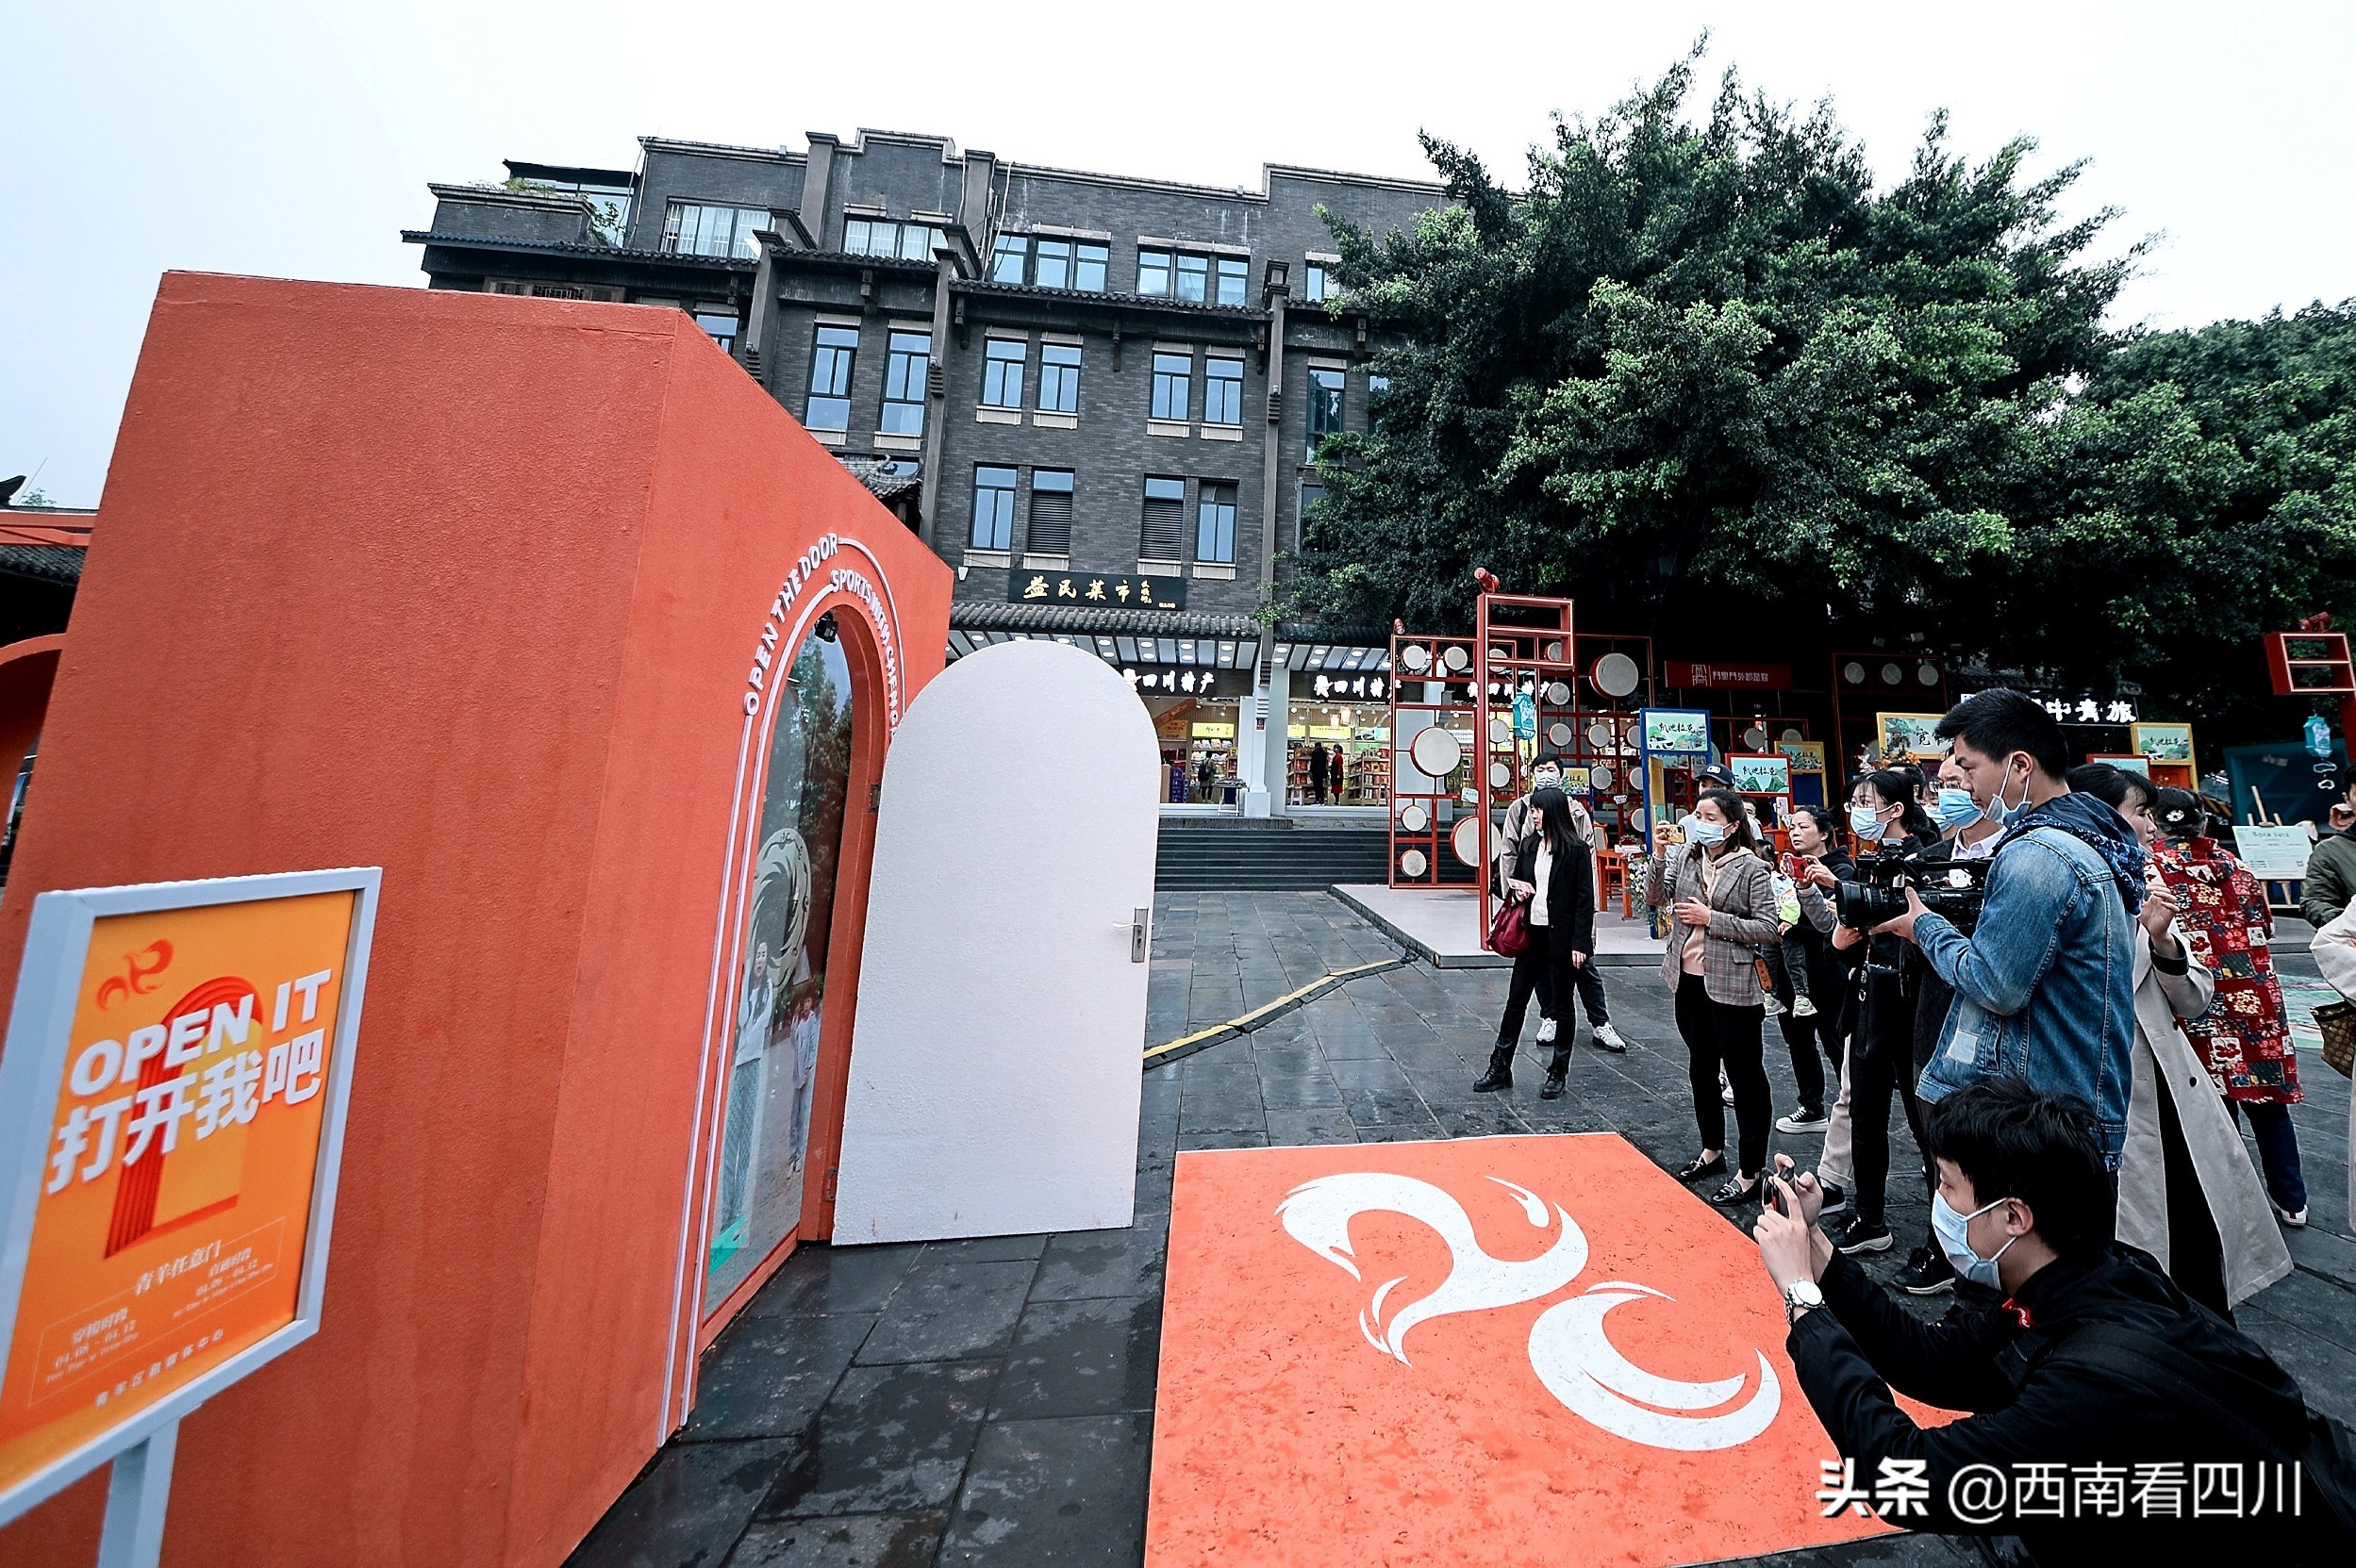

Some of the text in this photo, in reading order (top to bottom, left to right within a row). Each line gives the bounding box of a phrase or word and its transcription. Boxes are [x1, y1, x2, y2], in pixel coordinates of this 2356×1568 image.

[831, 569, 872, 604] SPORTS
[1023, 575, 1131, 603] 益民菜市
[743, 533, 838, 717] OPEN THE DOOR
[2031, 698, 2136, 723] 中青旅
[70, 968, 332, 1097] OPEN IT
[48, 1028, 325, 1196] 打开我吧
[135, 1239, 222, 1296] 青羊任意门
